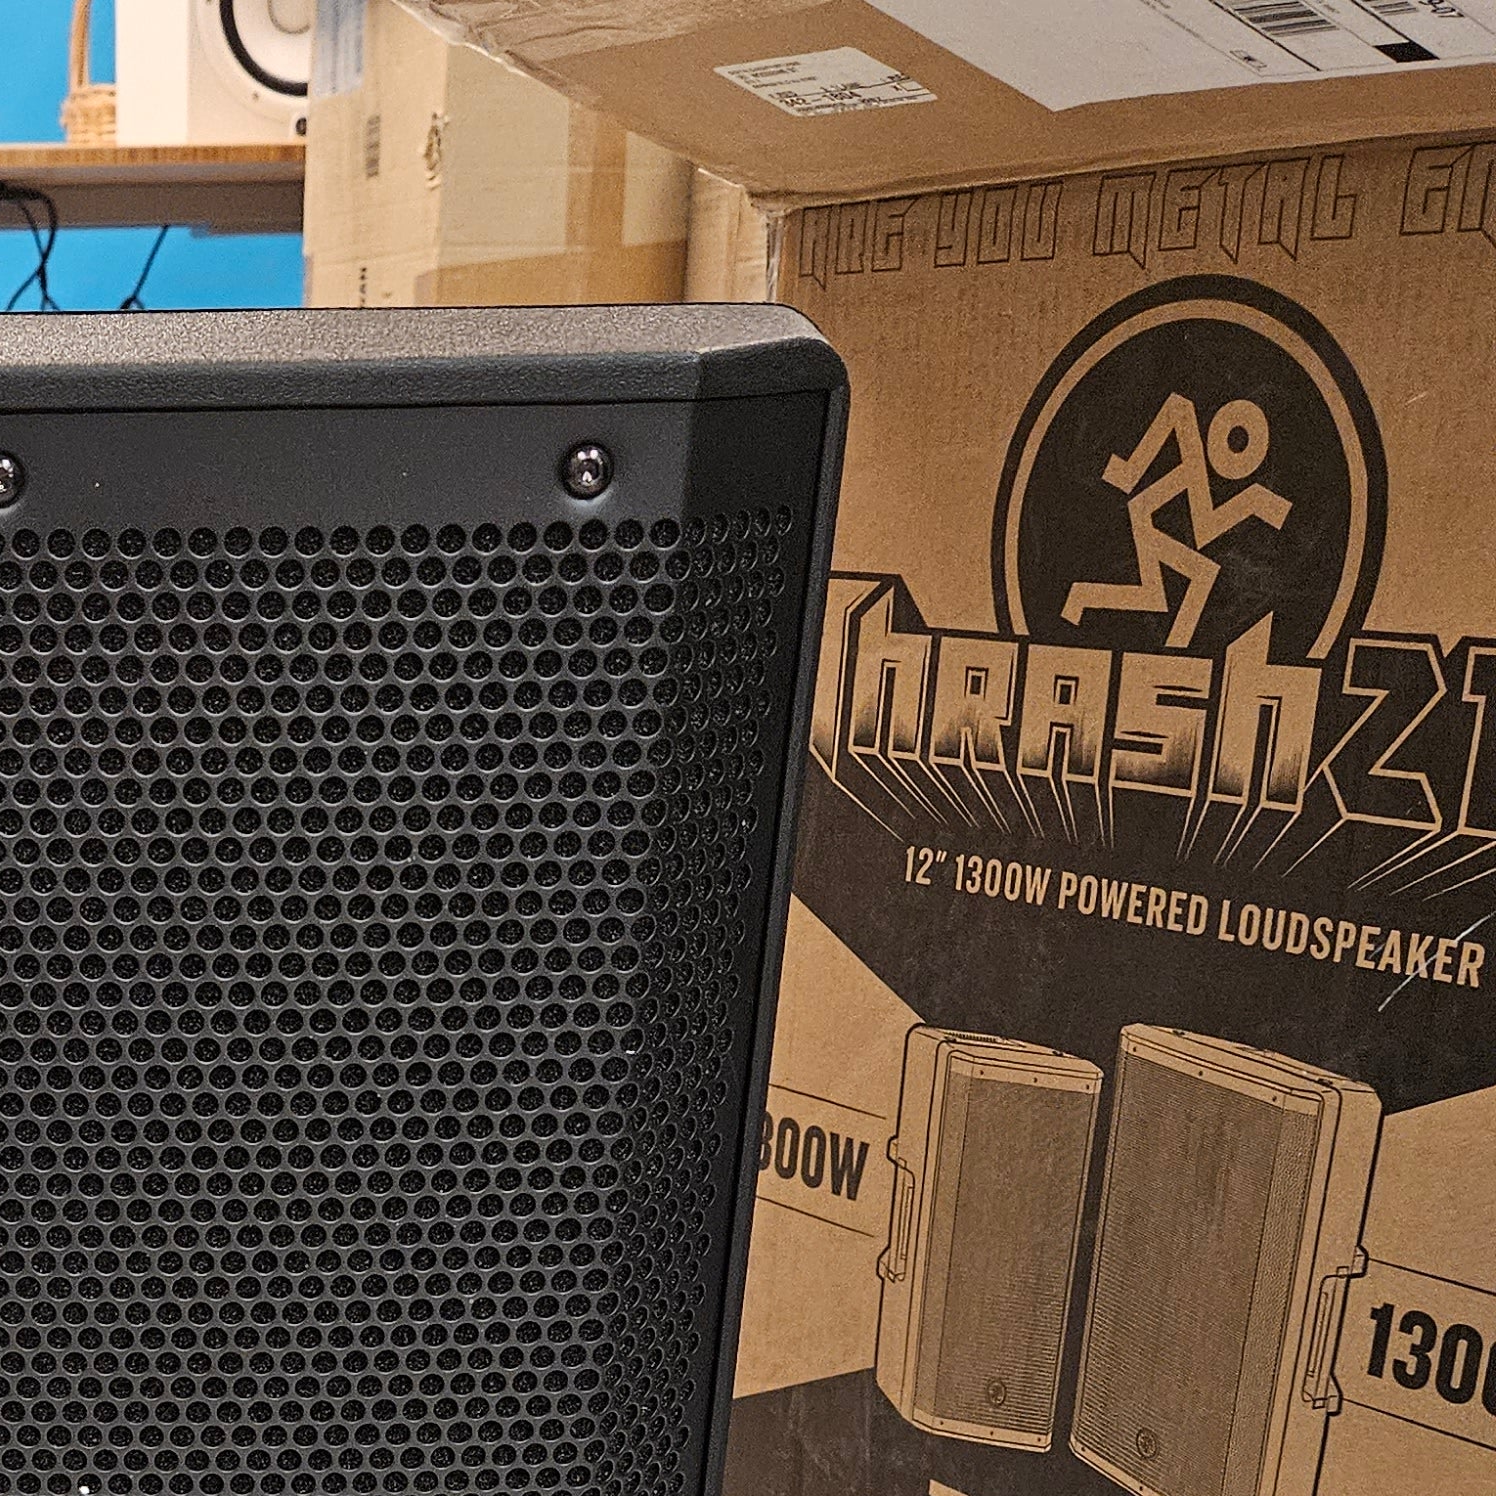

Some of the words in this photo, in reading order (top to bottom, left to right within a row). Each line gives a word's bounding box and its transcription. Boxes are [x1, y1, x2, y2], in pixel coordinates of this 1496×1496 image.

[799, 197, 918, 292] ARE
[934, 180, 1064, 269] YOU
[1092, 153, 1358, 271] METAL
[905, 845, 948, 886] 12"
[955, 854, 1052, 906] 1300W
[1058, 871, 1209, 936] POWERED
[1218, 899, 1485, 988] LOUDSPEAKER
